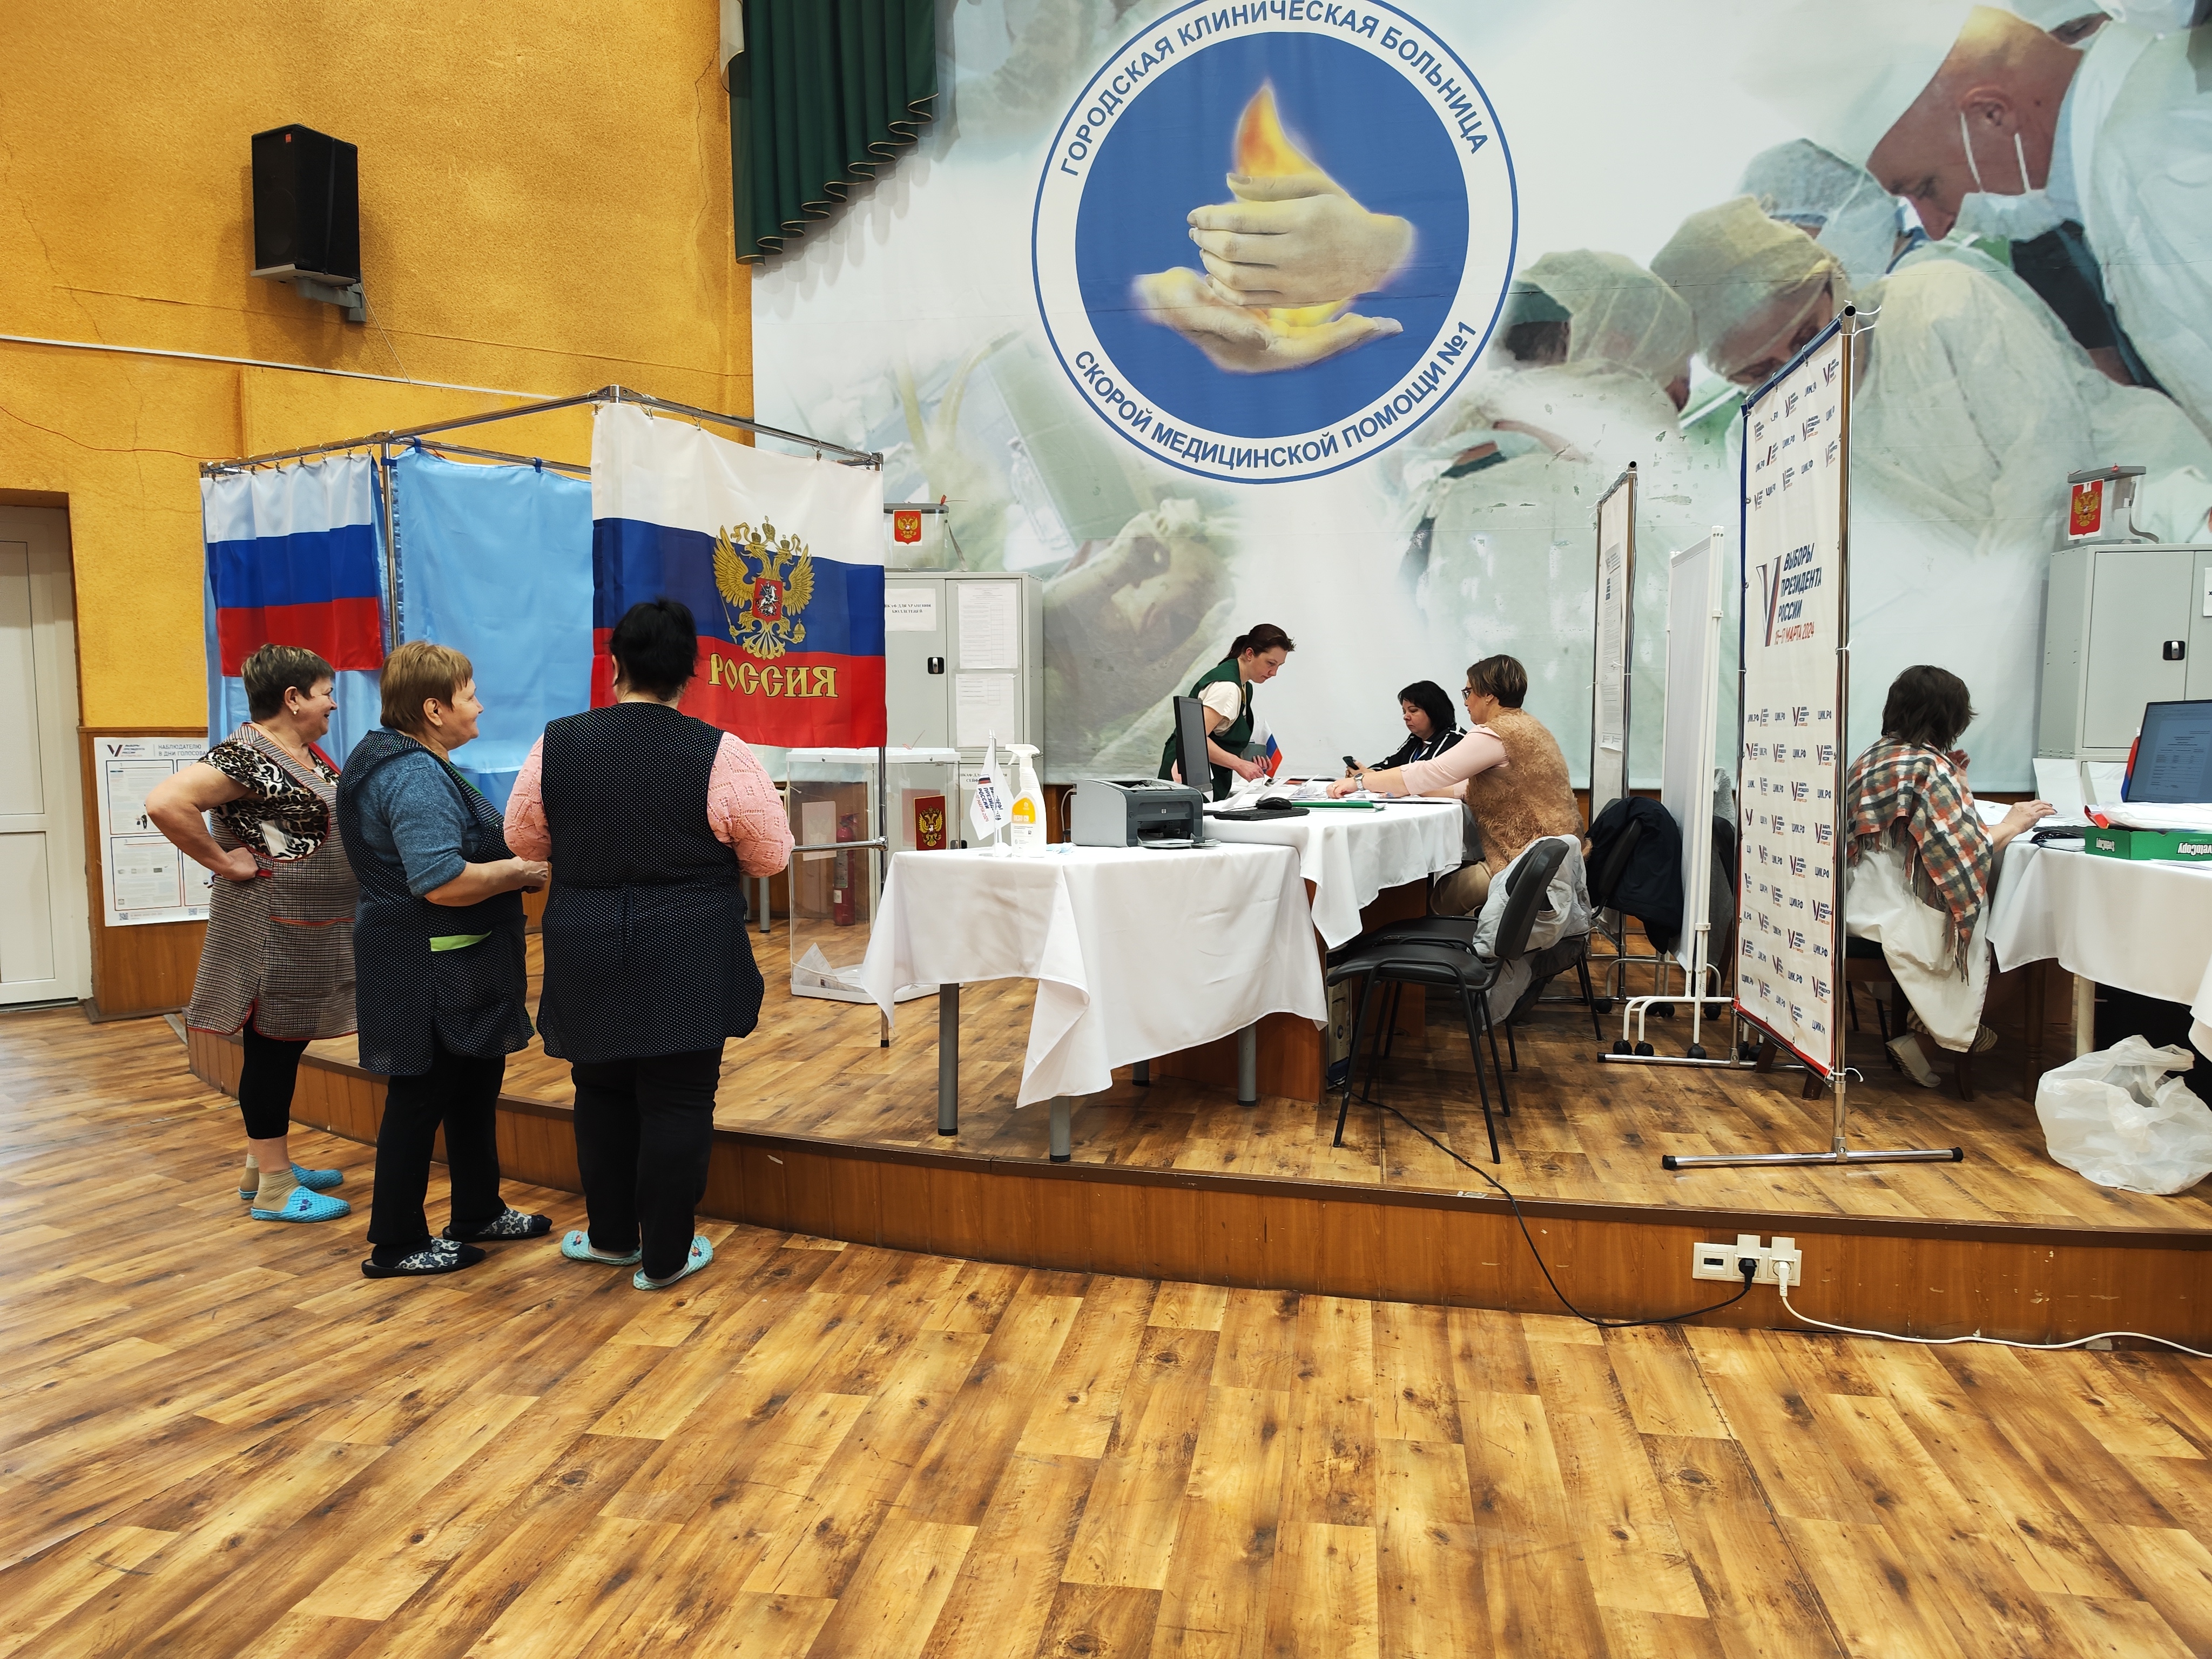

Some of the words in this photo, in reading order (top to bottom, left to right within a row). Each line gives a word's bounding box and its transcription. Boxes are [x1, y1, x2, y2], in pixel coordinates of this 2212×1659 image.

[1061, 37, 1174, 176] ГОРОДСКАЯ
[1178, 0, 1379, 45] КЛИНИЧЕСКАЯ
[1380, 26, 1488, 153] БОЛЬНИЦА
[1076, 351, 1152, 432] СКОРОЙ
[1152, 423, 1339, 469] МЕДИЦИНСКОЙ
[1342, 361, 1446, 447] ПОМОЩИ
[1783, 542, 1815, 571] ВЫБОРЫ
[1781, 567, 1822, 597] ПРЕЗИДЕНТА
[1777, 599, 1803, 623] РОССИИ
[1785, 624, 1802, 643] МАРТА
[1802, 622, 1815, 640] 2024
[708, 652, 839, 699] РОССИЯ
[978, 788, 989, 809] РОССИИ
[2177, 842, 2212, 856] vetoCopy
